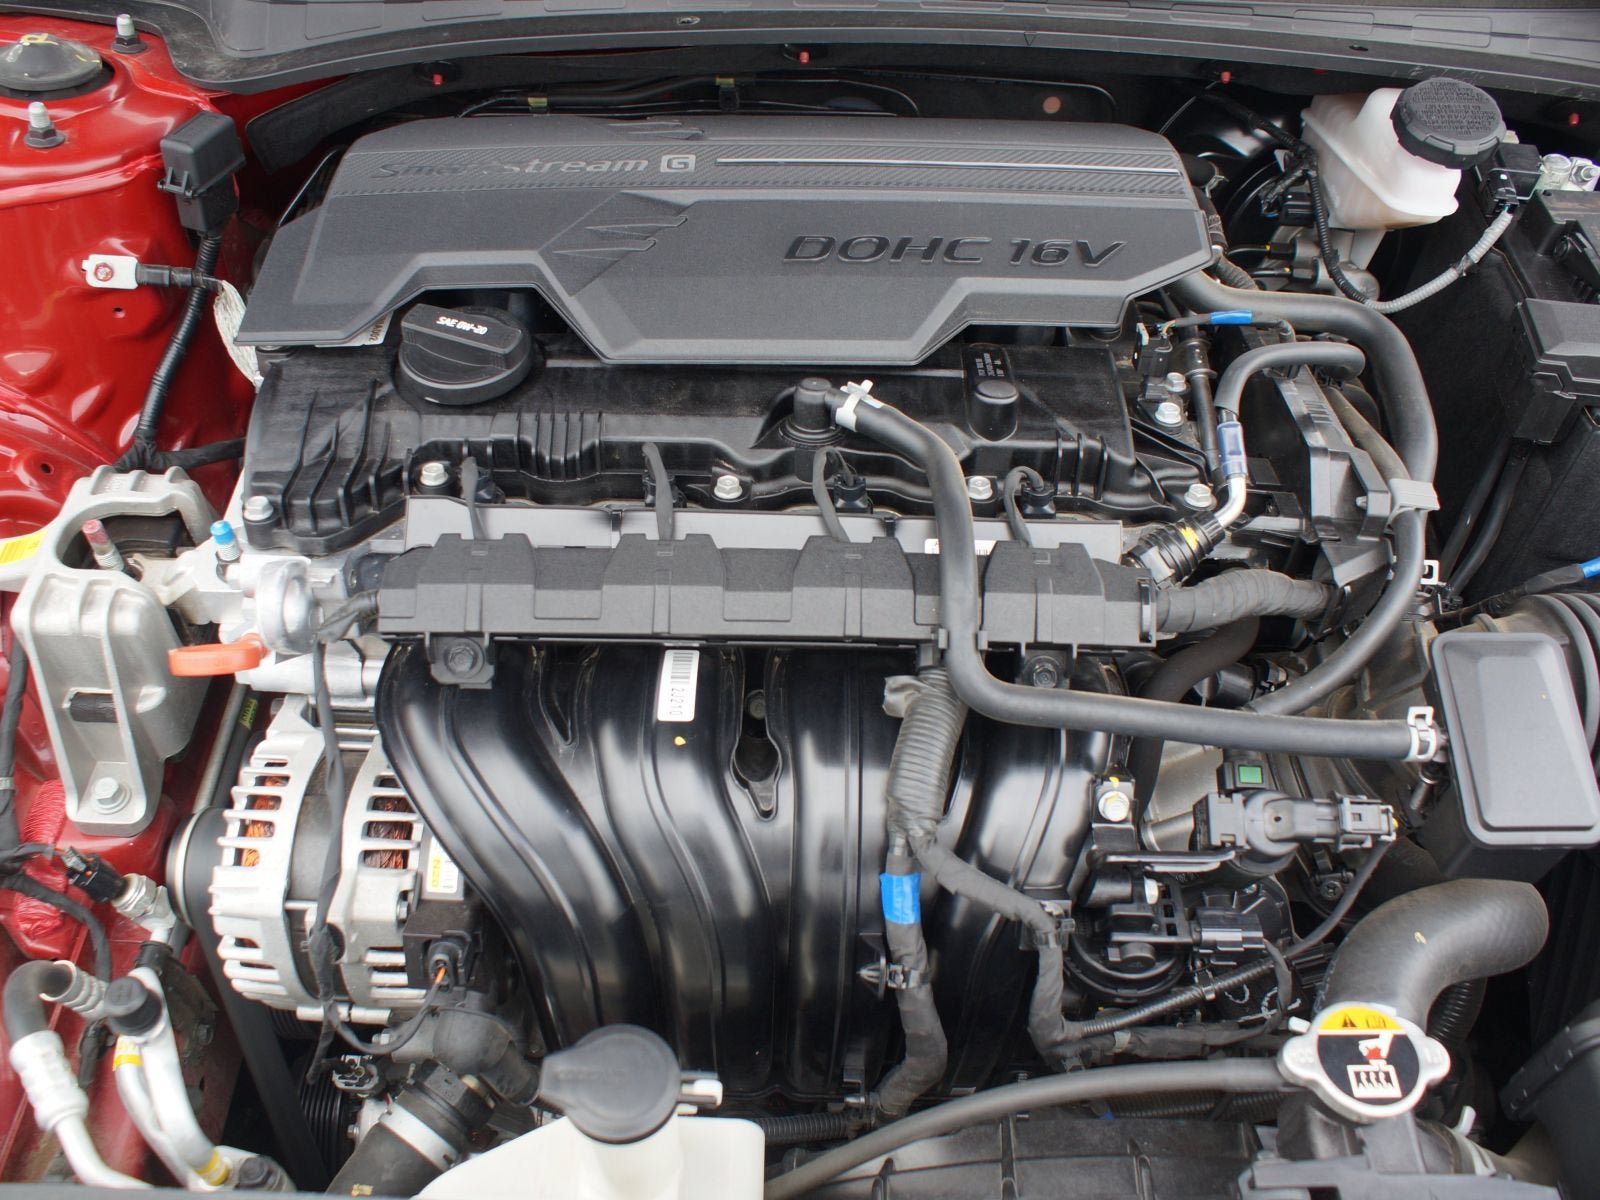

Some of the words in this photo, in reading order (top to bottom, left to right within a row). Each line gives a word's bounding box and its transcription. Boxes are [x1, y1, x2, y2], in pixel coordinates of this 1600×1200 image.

[371, 157, 649, 179] Smarstream
[662, 154, 695, 172] G
[784, 234, 993, 264] DOHC
[1009, 238, 1128, 269] 16V
[436, 316, 459, 328] SAE
